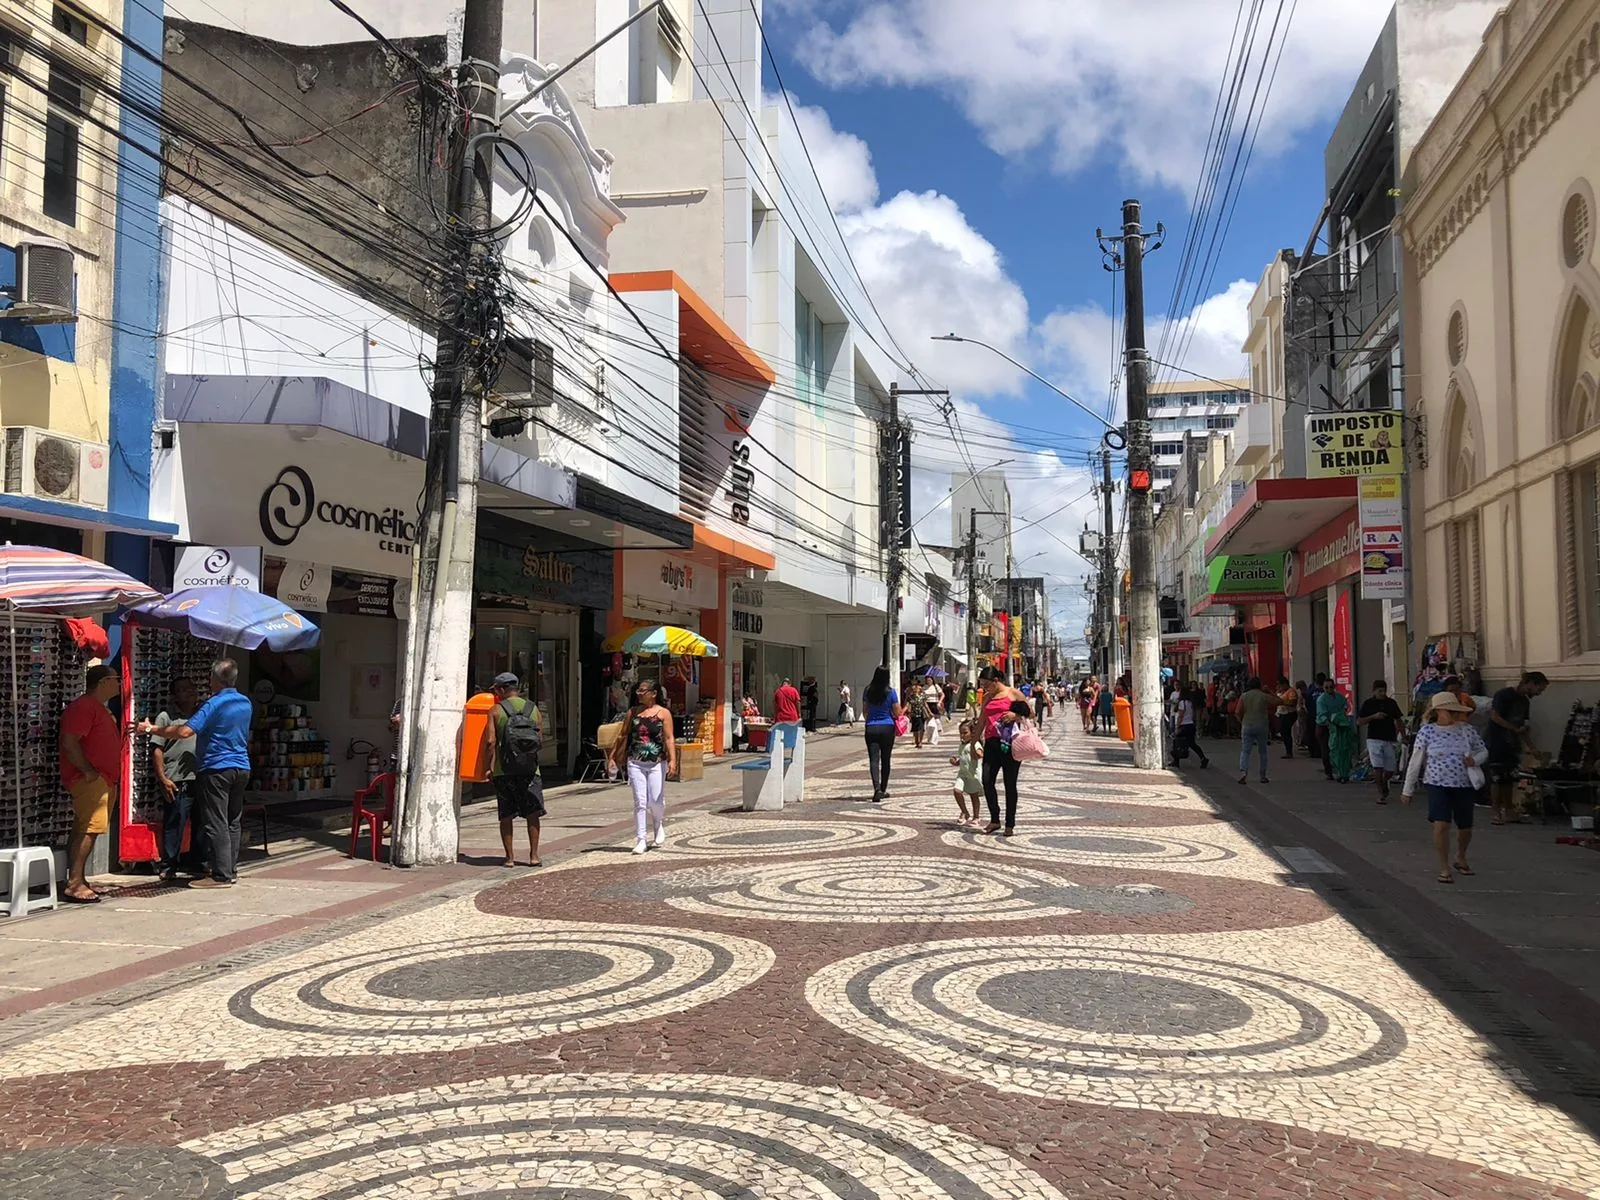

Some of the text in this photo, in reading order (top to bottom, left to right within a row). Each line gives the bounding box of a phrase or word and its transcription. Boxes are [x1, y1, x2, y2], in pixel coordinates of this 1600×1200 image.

[1311, 414, 1394, 433] IMPOSTO
[1342, 433, 1365, 448] DE
[1320, 449, 1390, 469] RENDA
[1339, 466, 1372, 475] Sala 11
[317, 501, 417, 541] cosmétic
